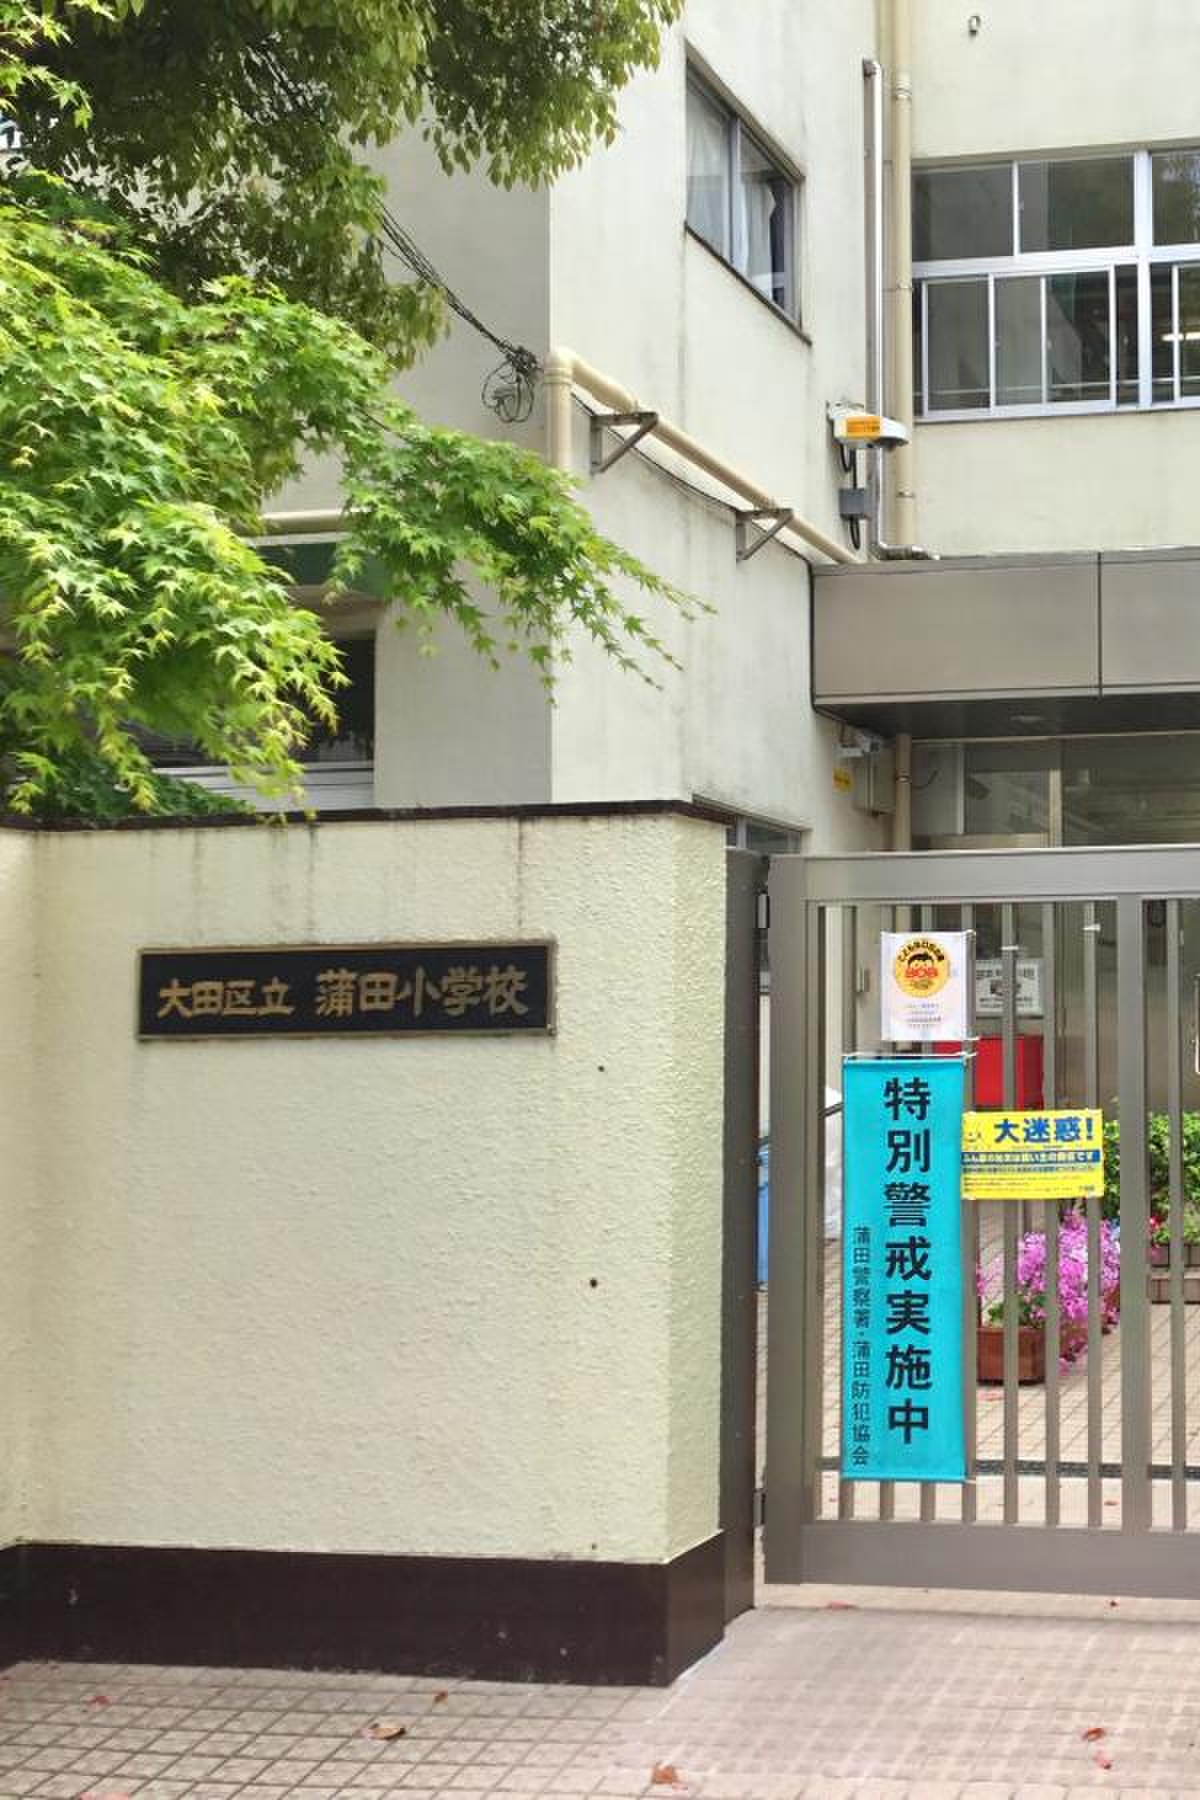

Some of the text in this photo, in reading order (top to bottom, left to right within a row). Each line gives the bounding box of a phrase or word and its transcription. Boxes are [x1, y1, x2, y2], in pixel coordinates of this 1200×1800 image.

[158, 965, 529, 1018] 大田区立 蒲田小学校
[851, 1226, 871, 1467] 蒲田警察署・蒲田防犯協会
[883, 1077, 933, 1445] 特別警戒実施中
